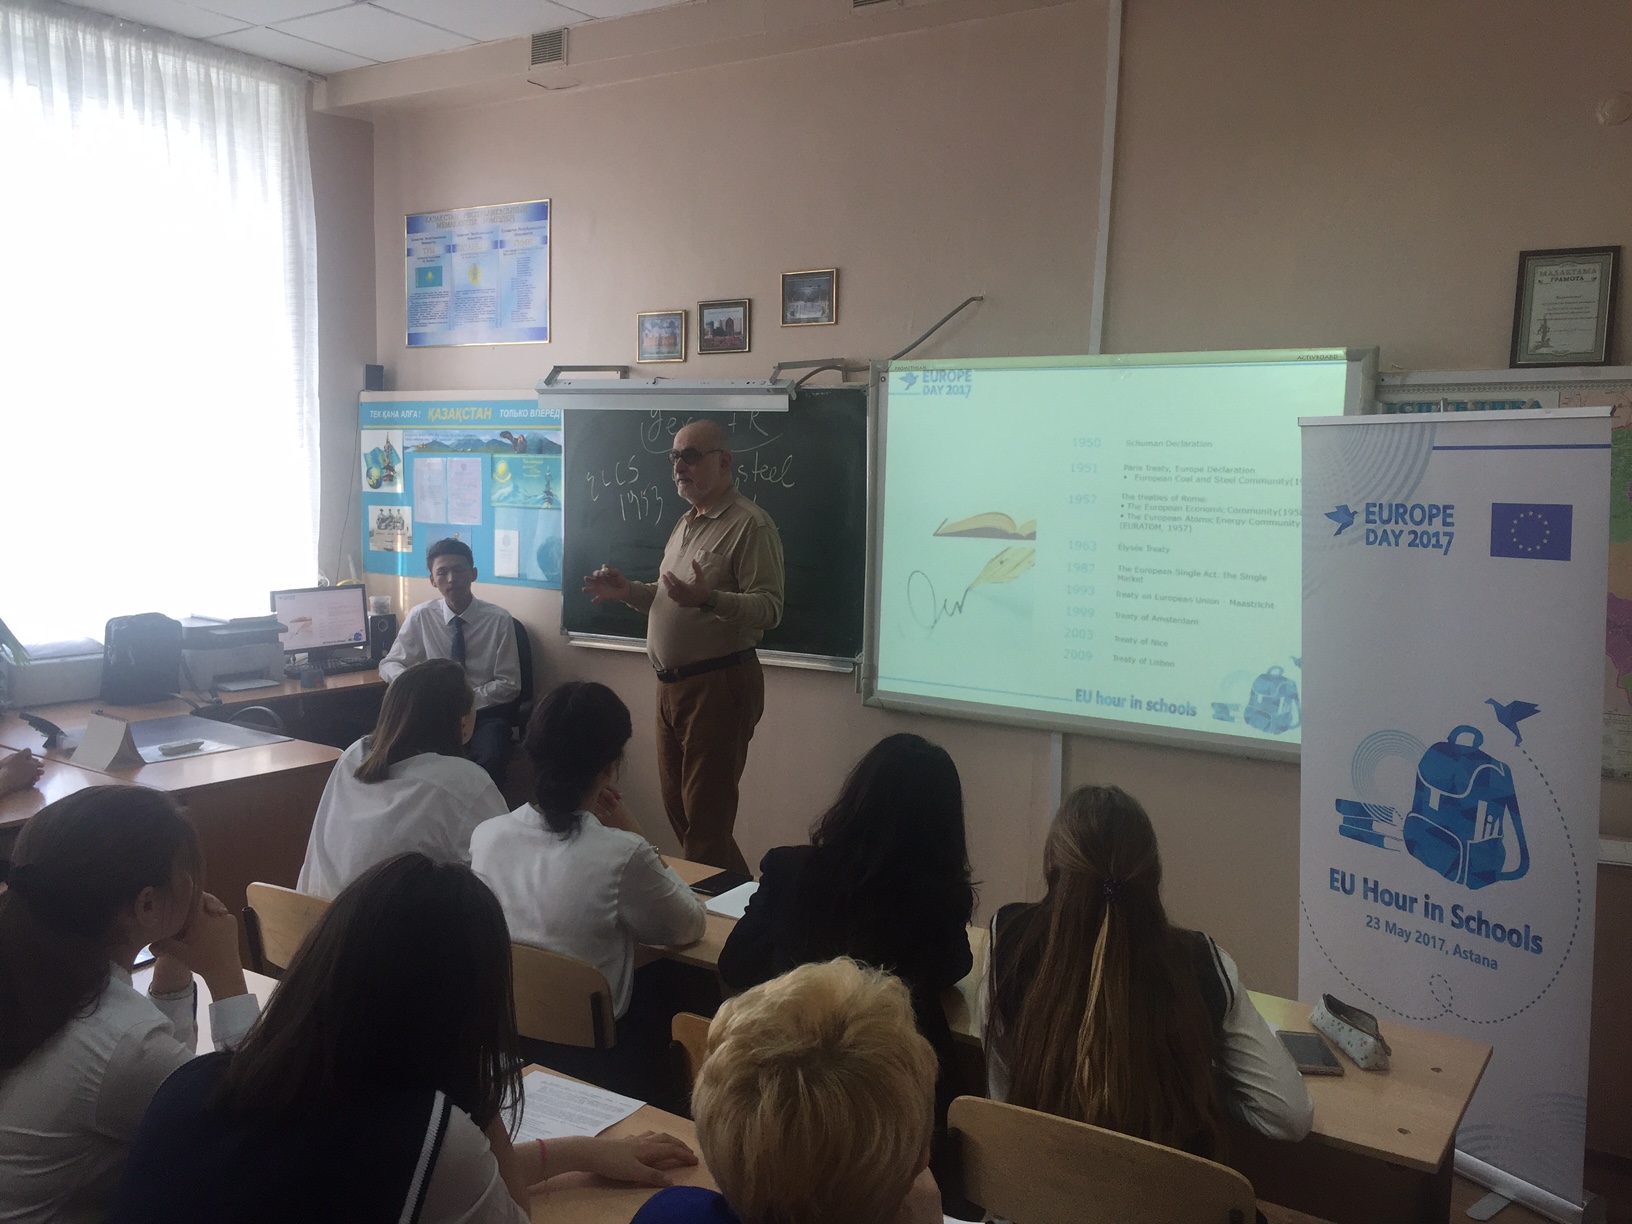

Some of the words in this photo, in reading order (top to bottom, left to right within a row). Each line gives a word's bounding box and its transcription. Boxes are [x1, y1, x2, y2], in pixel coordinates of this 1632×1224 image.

[1550, 275, 1584, 283] ГРАМОТА
[922, 369, 972, 383] EUROPE
[922, 384, 944, 395] DAY
[945, 385, 972, 399] 2017
[369, 410, 382, 419] ТЕК
[428, 407, 492, 422] ҚАЗАҚСТАН
[499, 409, 529, 418] ТОЛЬКО
[1072, 437, 1102, 448] 1950
[1126, 439, 1164, 448] Schuman
[1165, 440, 1213, 448] Declaration
[737, 451, 795, 488] steel
[1070, 462, 1098, 474] 1951
[1123, 464, 1143, 472] Paris
[1145, 465, 1172, 474] Treaty,
[1175, 465, 1204, 475] Europe
[1207, 466, 1256, 474] Declaration
[1134, 474, 1173, 483] European
[1174, 475, 1193, 483] Coal
[1195, 475, 1212, 484] and
[1214, 476, 1236, 484] Steel
[1068, 494, 1098, 505] 1957
[1121, 493, 1136, 501] The
[1137, 493, 1169, 502] treaties
[1170, 494, 1180, 502] of
[1181, 495, 1208, 503] Rome:
[1127, 502, 1142, 511] The
[1144, 503, 1183, 512] European
[1185, 504, 1226, 514] Economic
[1365, 502, 1455, 528] EUROPE
[1119, 521, 1164, 531] (EURATOM,
[1167, 523, 1193, 533] 1957)
[1127, 512, 1142, 521] The
[1144, 513, 1183, 523] European
[1184, 515, 1215, 524] Atomic
[1215, 516, 1246, 526] Energy
[1248, 517, 1301, 528] Community
[1068, 540, 1098, 551] 1963
[1146, 544, 1171, 554] Treaty
[1365, 528, 1404, 547] DAY
[1407, 529, 1455, 556] 2017
[1067, 562, 1096, 573] 1987
[1118, 564, 1133, 573] The
[1134, 566, 1173, 576] European
[1175, 568, 1202, 578] Single
[1223, 571, 1238, 580] the
[1239, 572, 1268, 583] Single
[1117, 574, 1144, 584] Market
[1066, 585, 1096, 596] 1993
[1116, 590, 1139, 600] Treaty
[1141, 592, 1153, 600] on
[1154, 593, 1194, 604] European
[1195, 596, 1220, 605] Union
[1229, 598, 1275, 610] Maastricht
[1066, 606, 1096, 618] 1999
[1115, 612, 1139, 622] Treaty
[1140, 613, 1150, 621] of
[1151, 614, 1200, 626] Amsterdam
[1064, 627, 1095, 641] 2003
[1114, 635, 1138, 646] Treaty
[1140, 637, 1149, 646] of
[1150, 638, 1169, 648] Nice
[1063, 648, 1094, 661] 2009
[1112, 654, 1136, 665] Treaty
[1138, 657, 1147, 665] of
[1149, 658, 1176, 668] Lisbon
[1075, 688, 1092, 704] EU
[1096, 690, 1127, 708] hour
[1130, 694, 1143, 710] in
[1146, 697, 1197, 717] schools
[1329, 867, 1356, 896] EU
[1362, 876, 1418, 914] Hour
[1423, 893, 1445, 923] in
[1450, 903, 1544, 955] Schools
[1365, 914, 1381, 930] 23
[1385, 919, 1412, 944] May
[1415, 929, 1450, 956] 2017,
[1452, 943, 1498, 971] Astana
